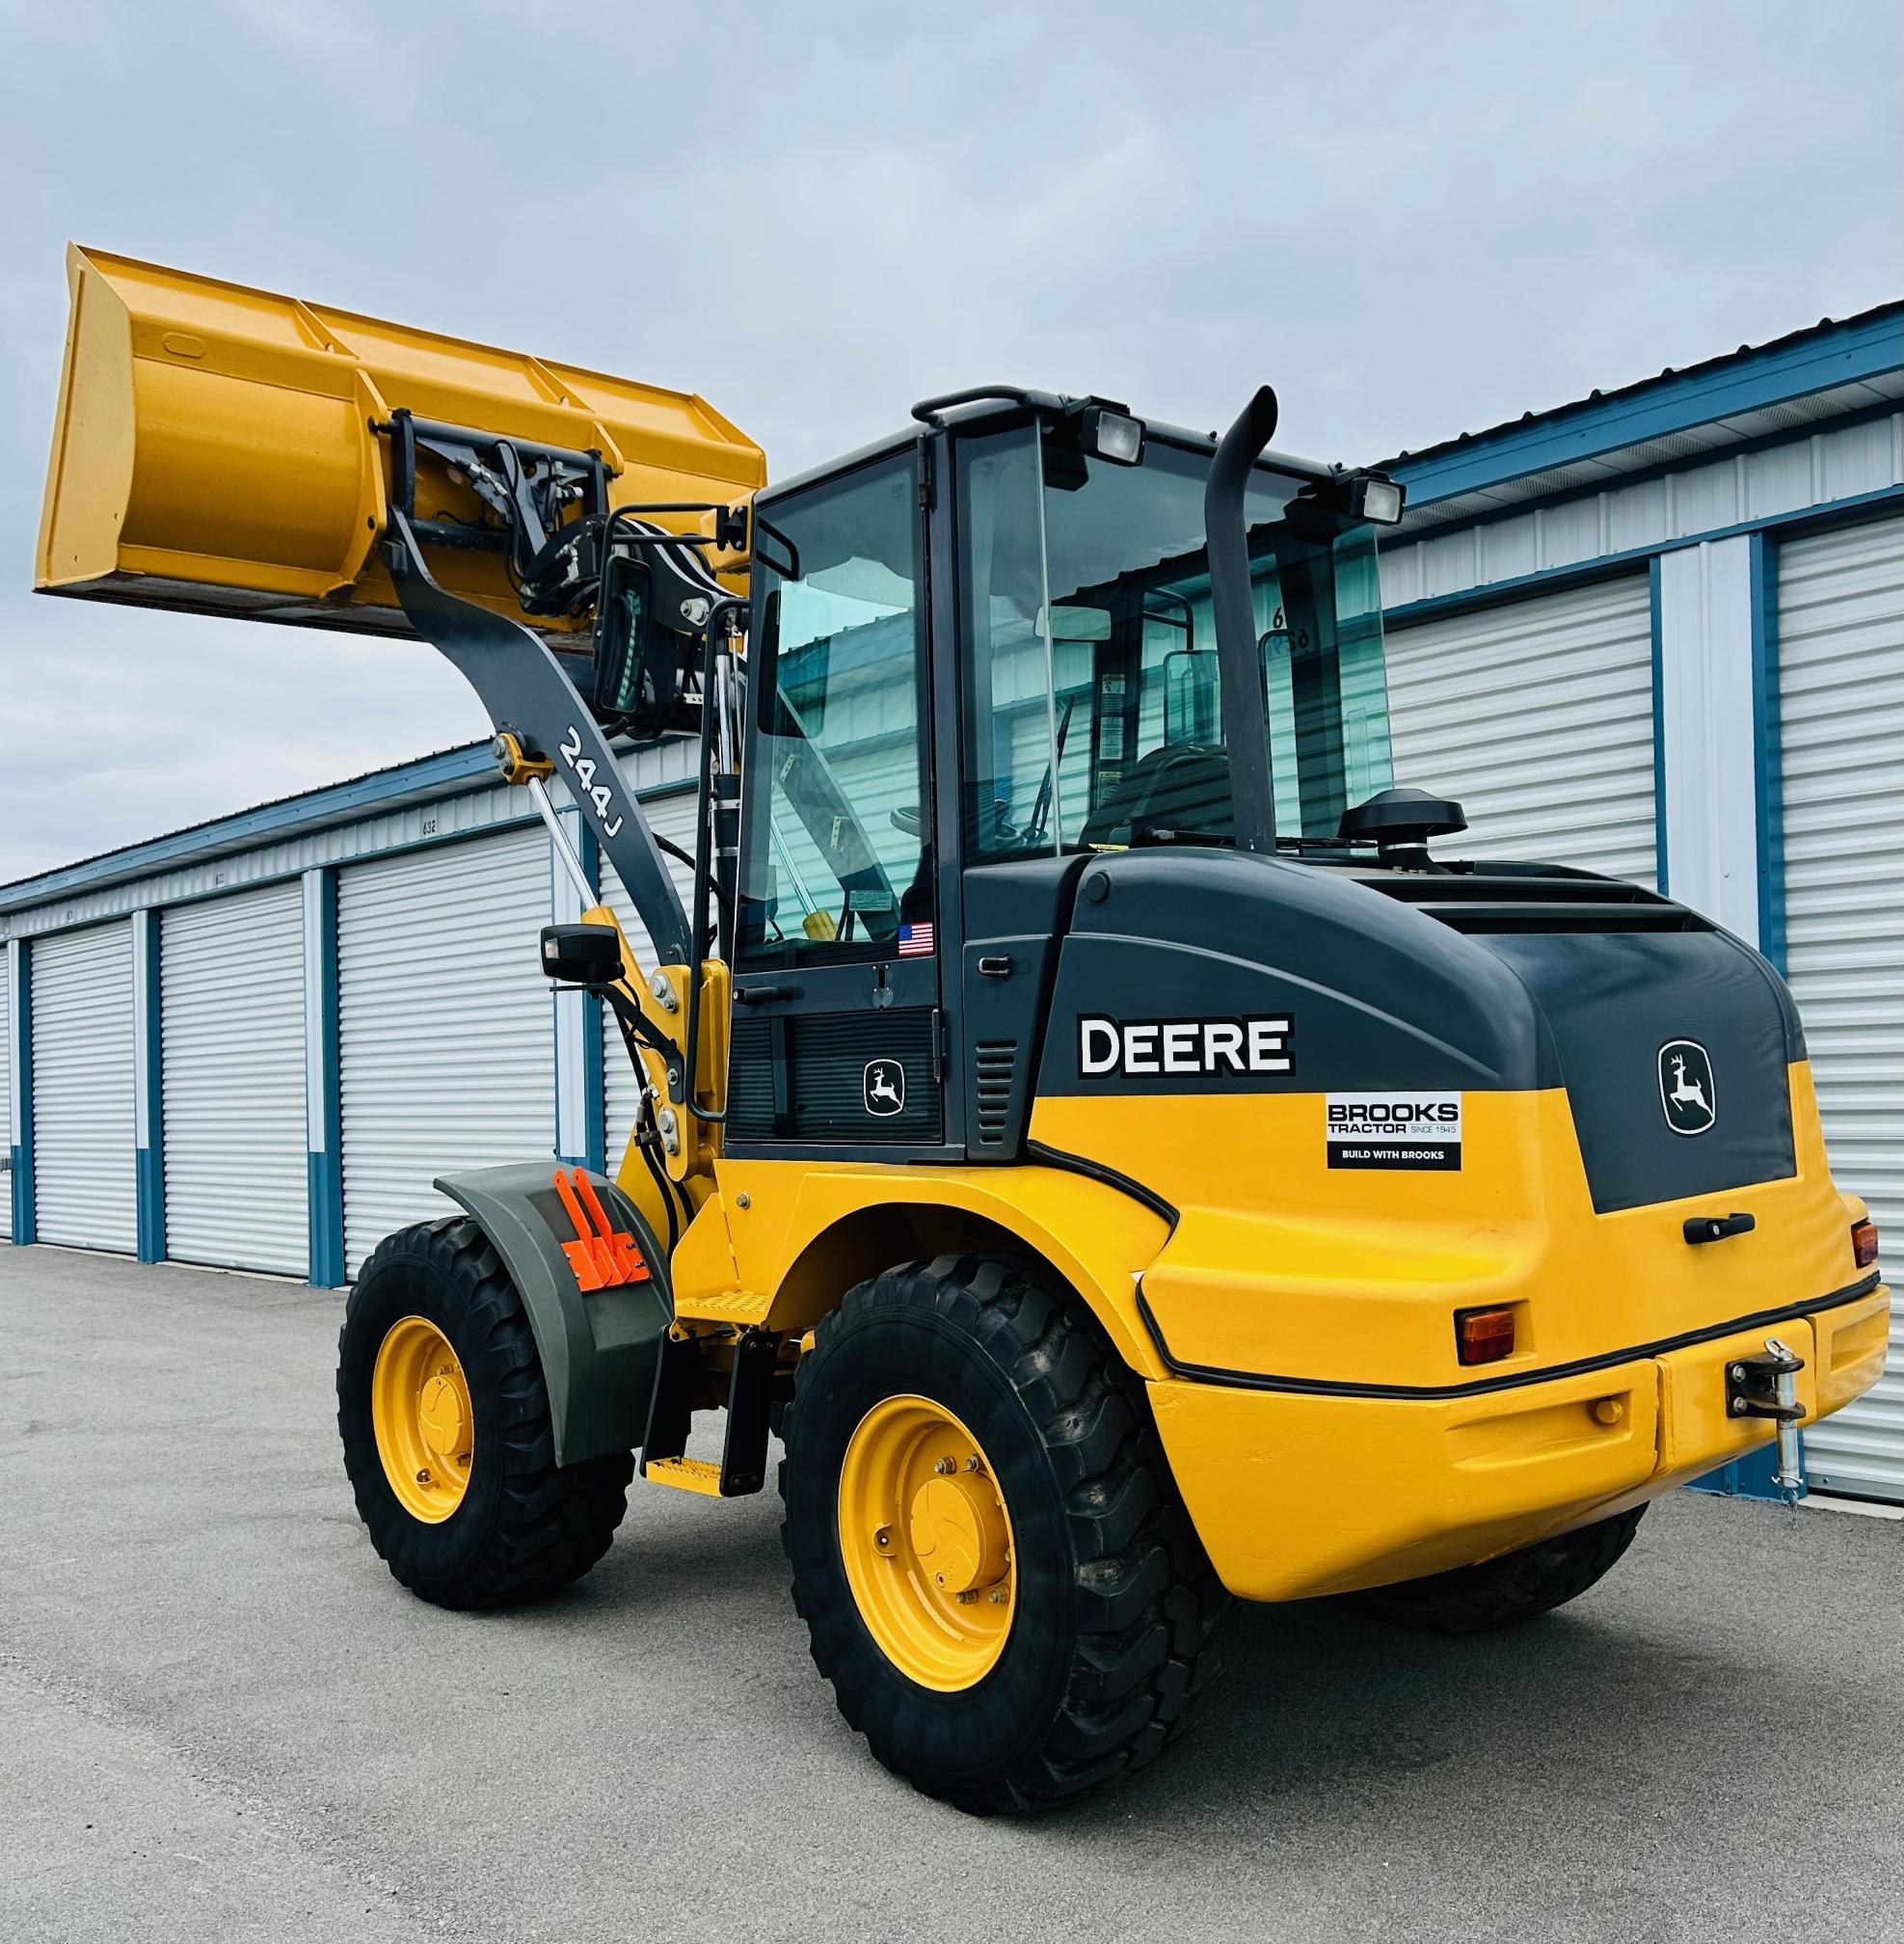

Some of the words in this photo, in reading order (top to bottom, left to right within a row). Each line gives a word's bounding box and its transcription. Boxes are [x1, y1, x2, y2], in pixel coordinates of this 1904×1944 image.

[559, 725, 624, 837] 244J
[1081, 1018, 1291, 1073] DEERE
[1327, 1102, 1459, 1122] BROOKS
[1327, 1122, 1407, 1134] TRACTOR
[1409, 1124, 1434, 1134] SINCE
[1435, 1124, 1457, 1134] 1945
[1342, 1149, 1372, 1159] BUILD
[1372, 1150, 1400, 1160] WITH
[1401, 1150, 1445, 1160] BROOKS
